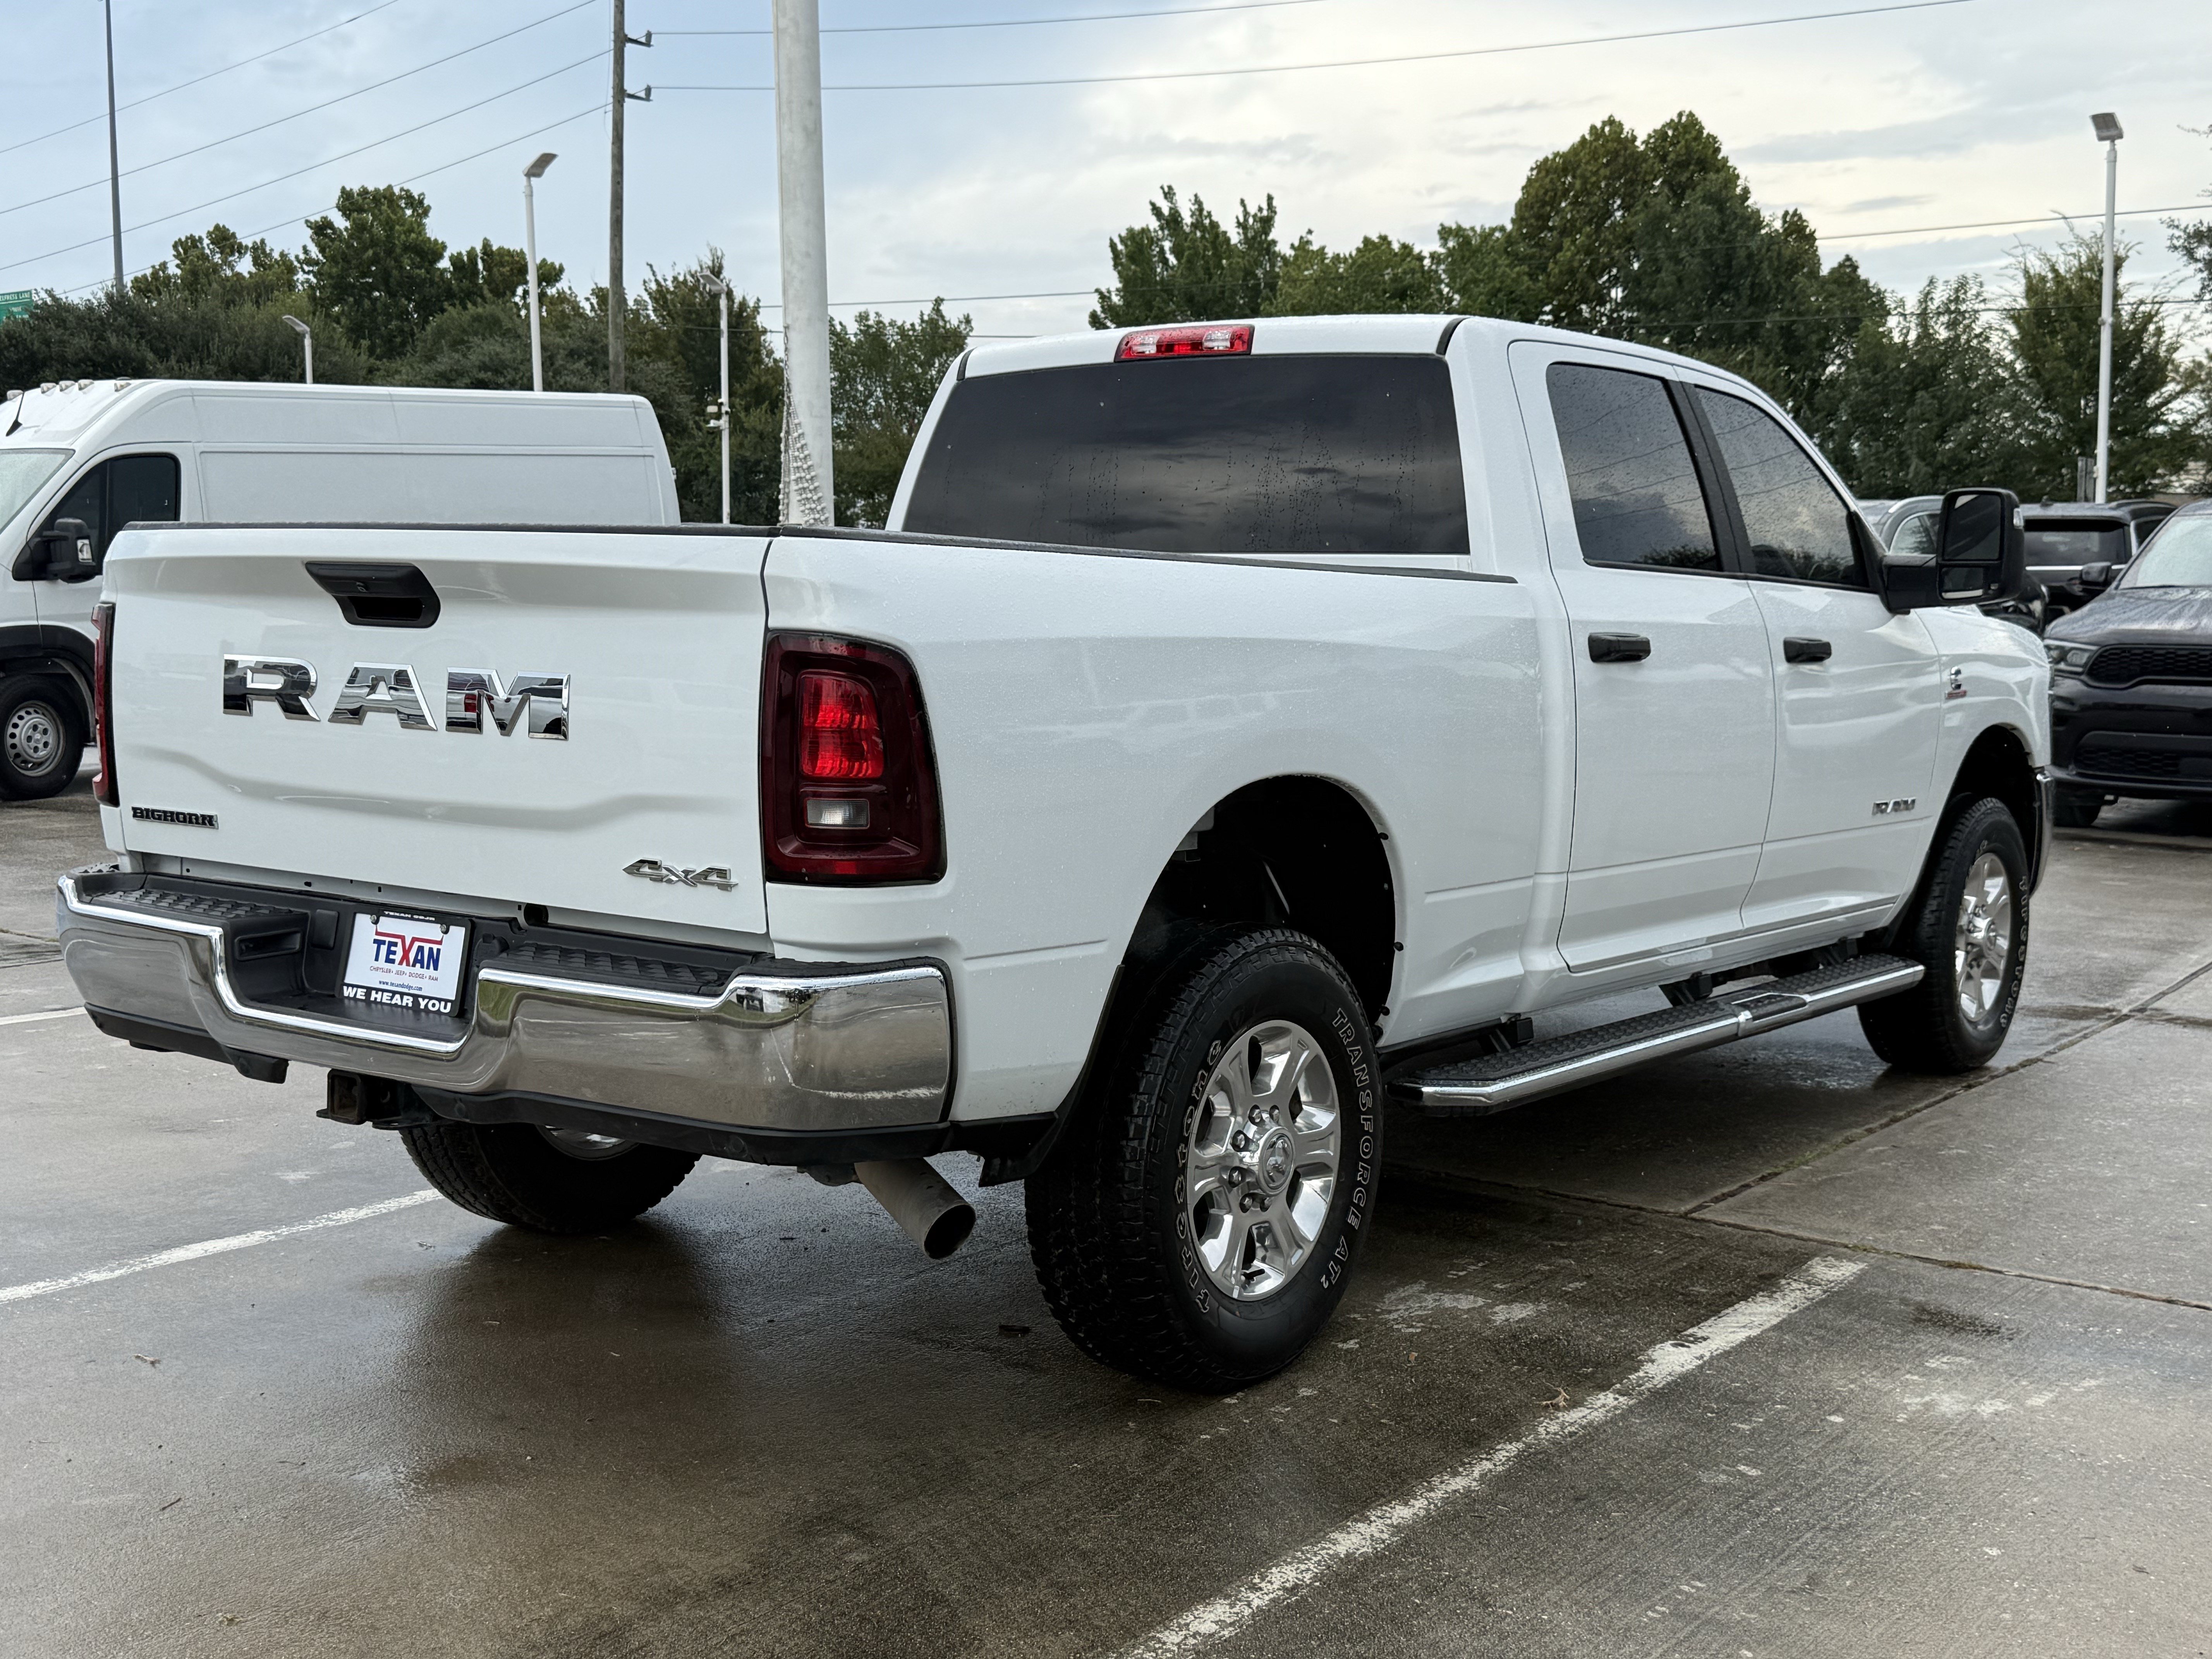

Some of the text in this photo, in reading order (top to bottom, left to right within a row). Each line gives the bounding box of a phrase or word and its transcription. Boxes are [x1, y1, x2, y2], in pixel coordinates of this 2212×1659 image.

[223, 654, 570, 740] RAM
[131, 806, 219, 830] BIGHORN
[1872, 797, 1917, 816] RAM
[373, 929, 444, 972] TEXAN
[370, 966, 391, 974] CHRYSLER
[379, 980, 422, 991] www.texandodge.com
[343, 986, 452, 1013] WE HEAR YOU
[1332, 1008, 1373, 1230] TRANSFORCE
